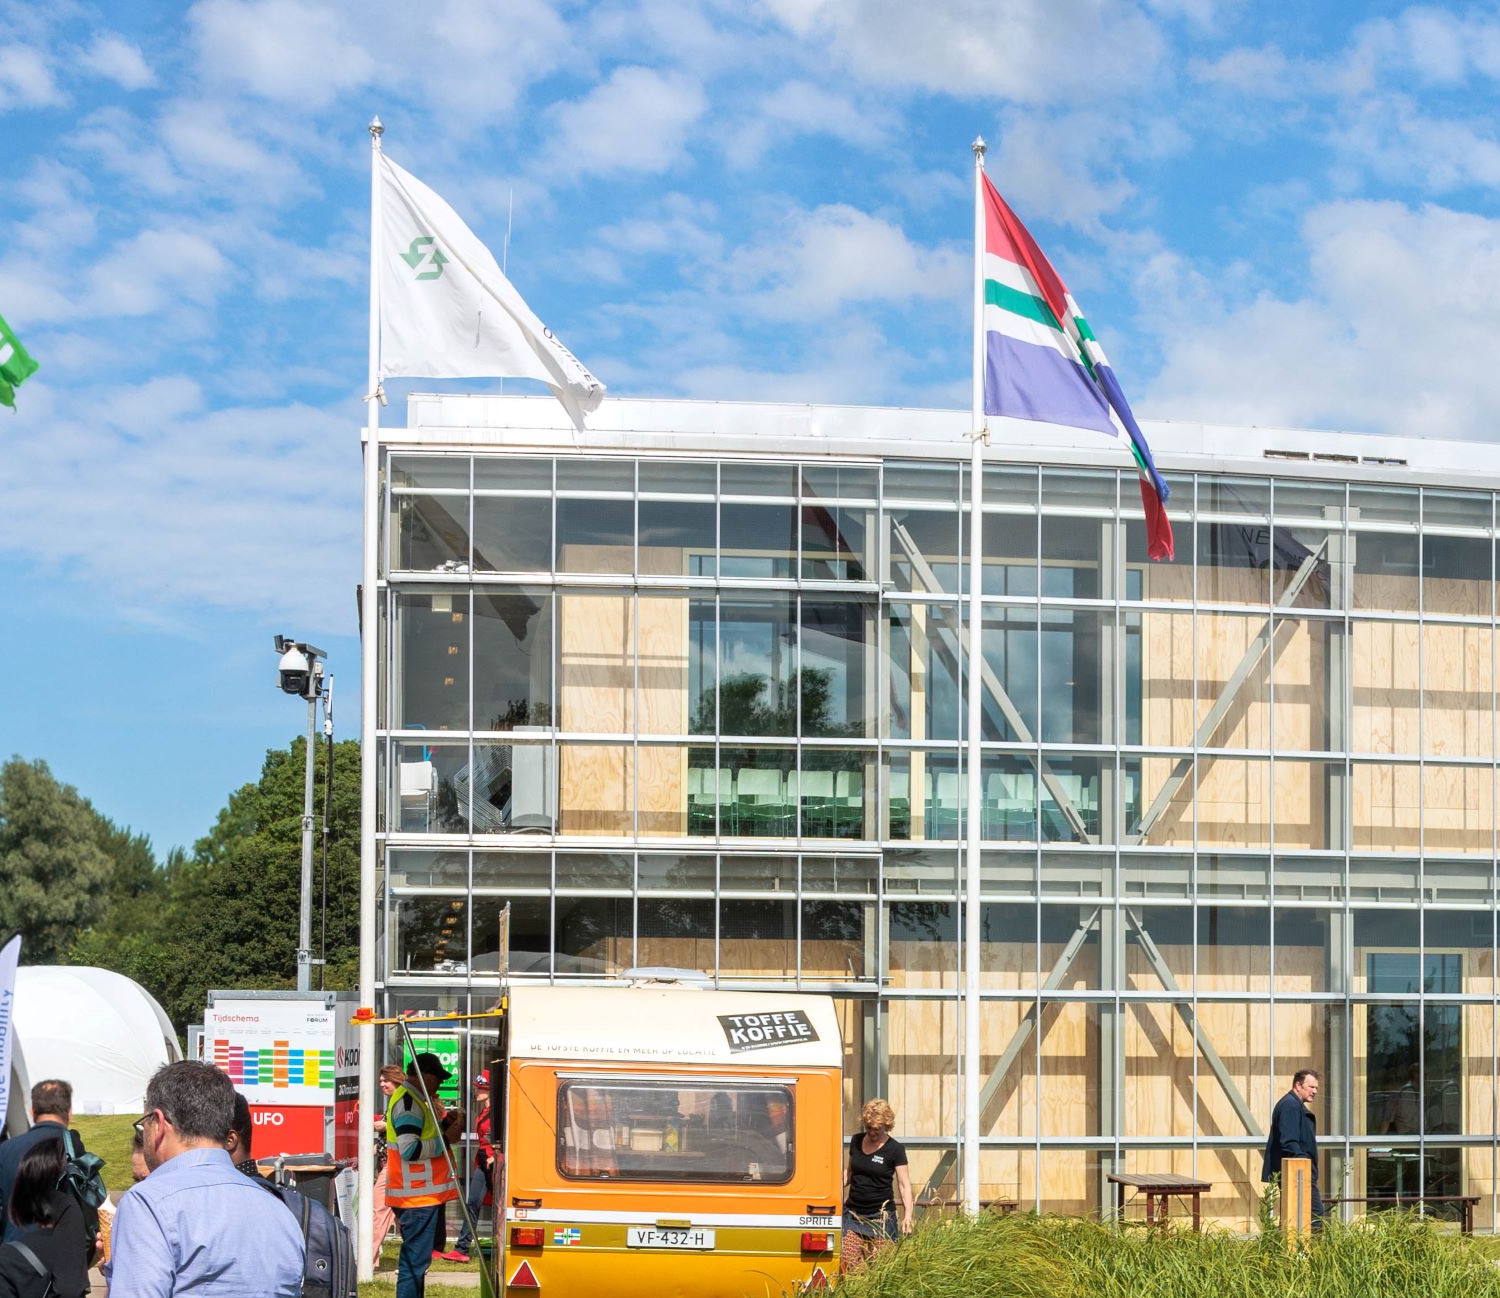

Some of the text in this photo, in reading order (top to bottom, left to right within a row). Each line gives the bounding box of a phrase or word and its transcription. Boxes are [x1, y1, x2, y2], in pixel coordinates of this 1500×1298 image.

[213, 1014, 260, 1023] Tijdschema
[728, 1012, 800, 1028] TOFFE
[729, 1023, 812, 1045] KOFFIE
[253, 1112, 284, 1126] UFO
[344, 1111, 354, 1125] UFO
[799, 1216, 834, 1226] SPRITE
[637, 1230, 705, 1246] VF-432-H
